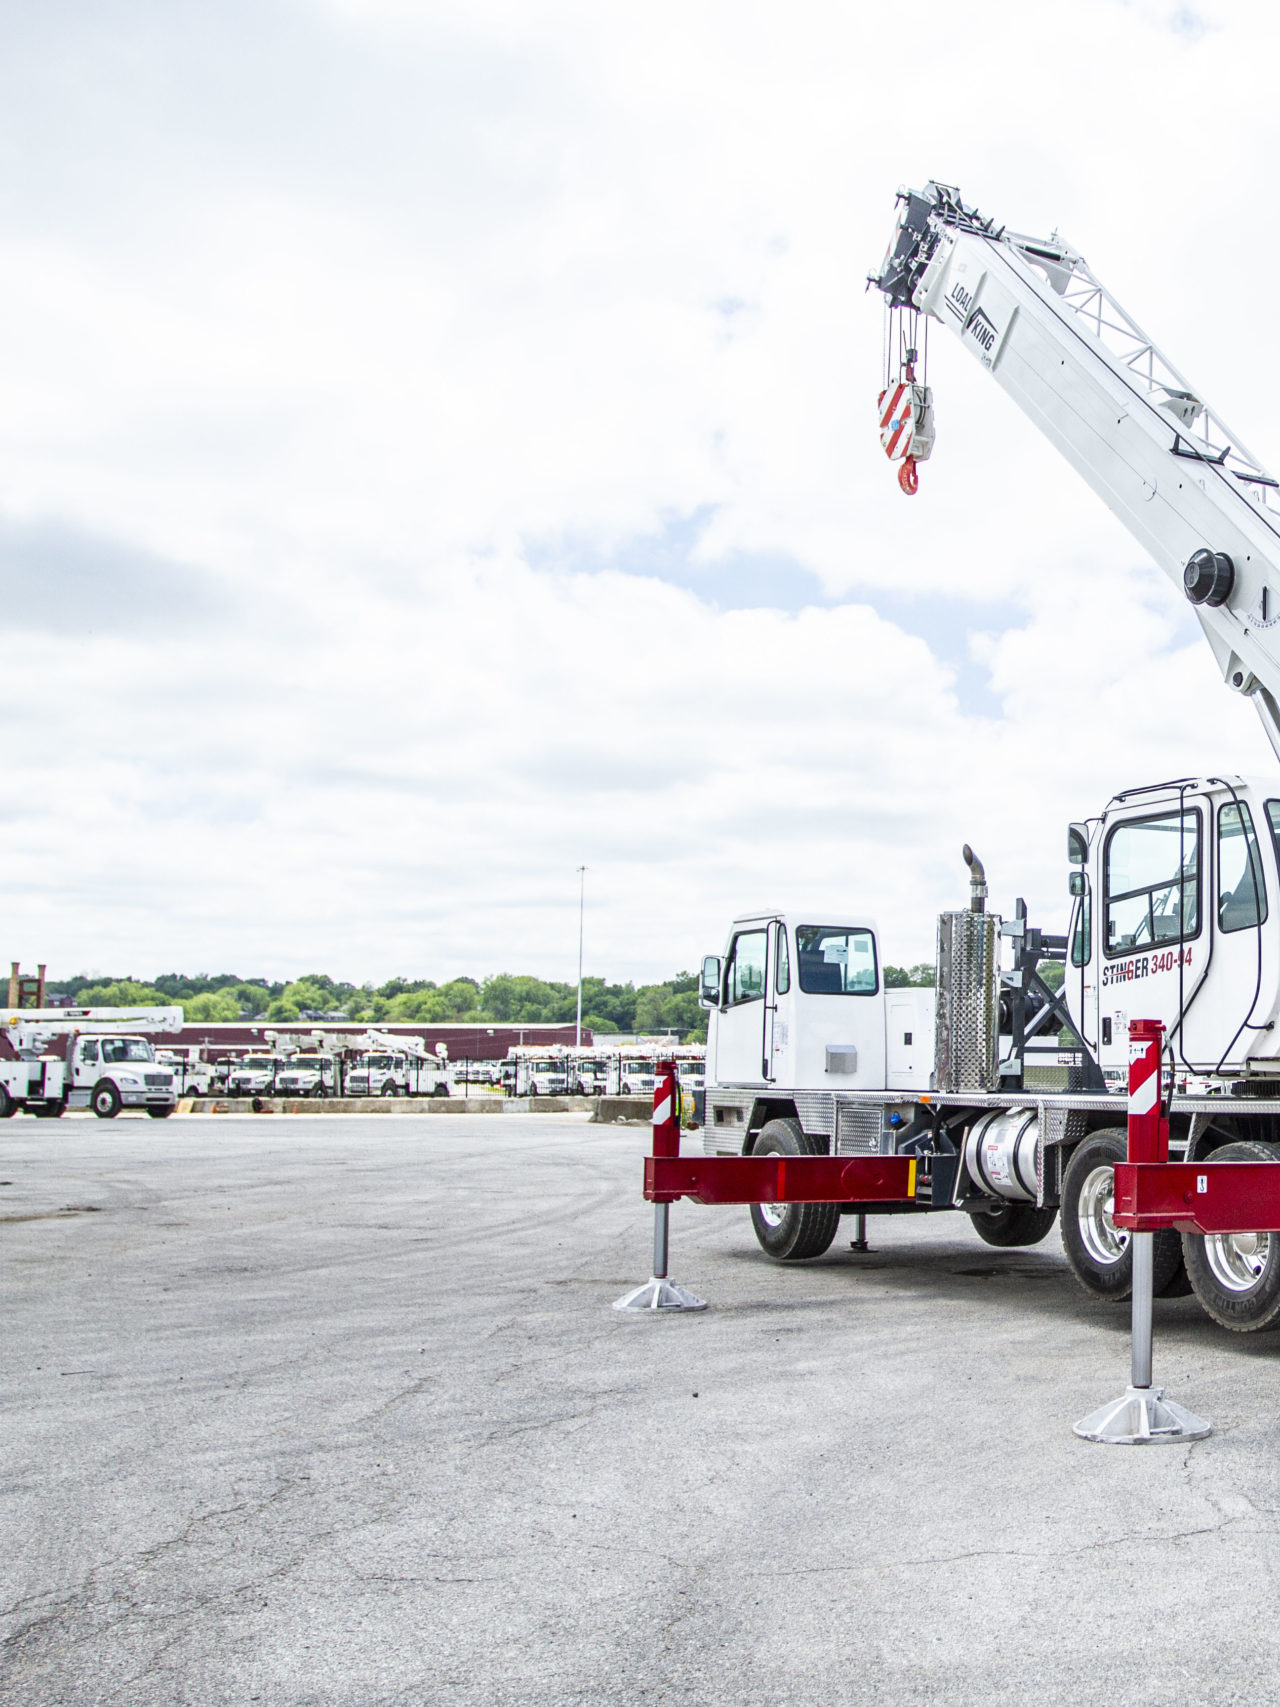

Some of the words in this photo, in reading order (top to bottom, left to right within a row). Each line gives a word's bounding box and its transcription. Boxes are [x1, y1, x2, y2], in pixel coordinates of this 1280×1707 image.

[971, 318, 995, 351] KING
[1102, 956, 1149, 987] STINGER
[1151, 946, 1192, 975] 340-94
